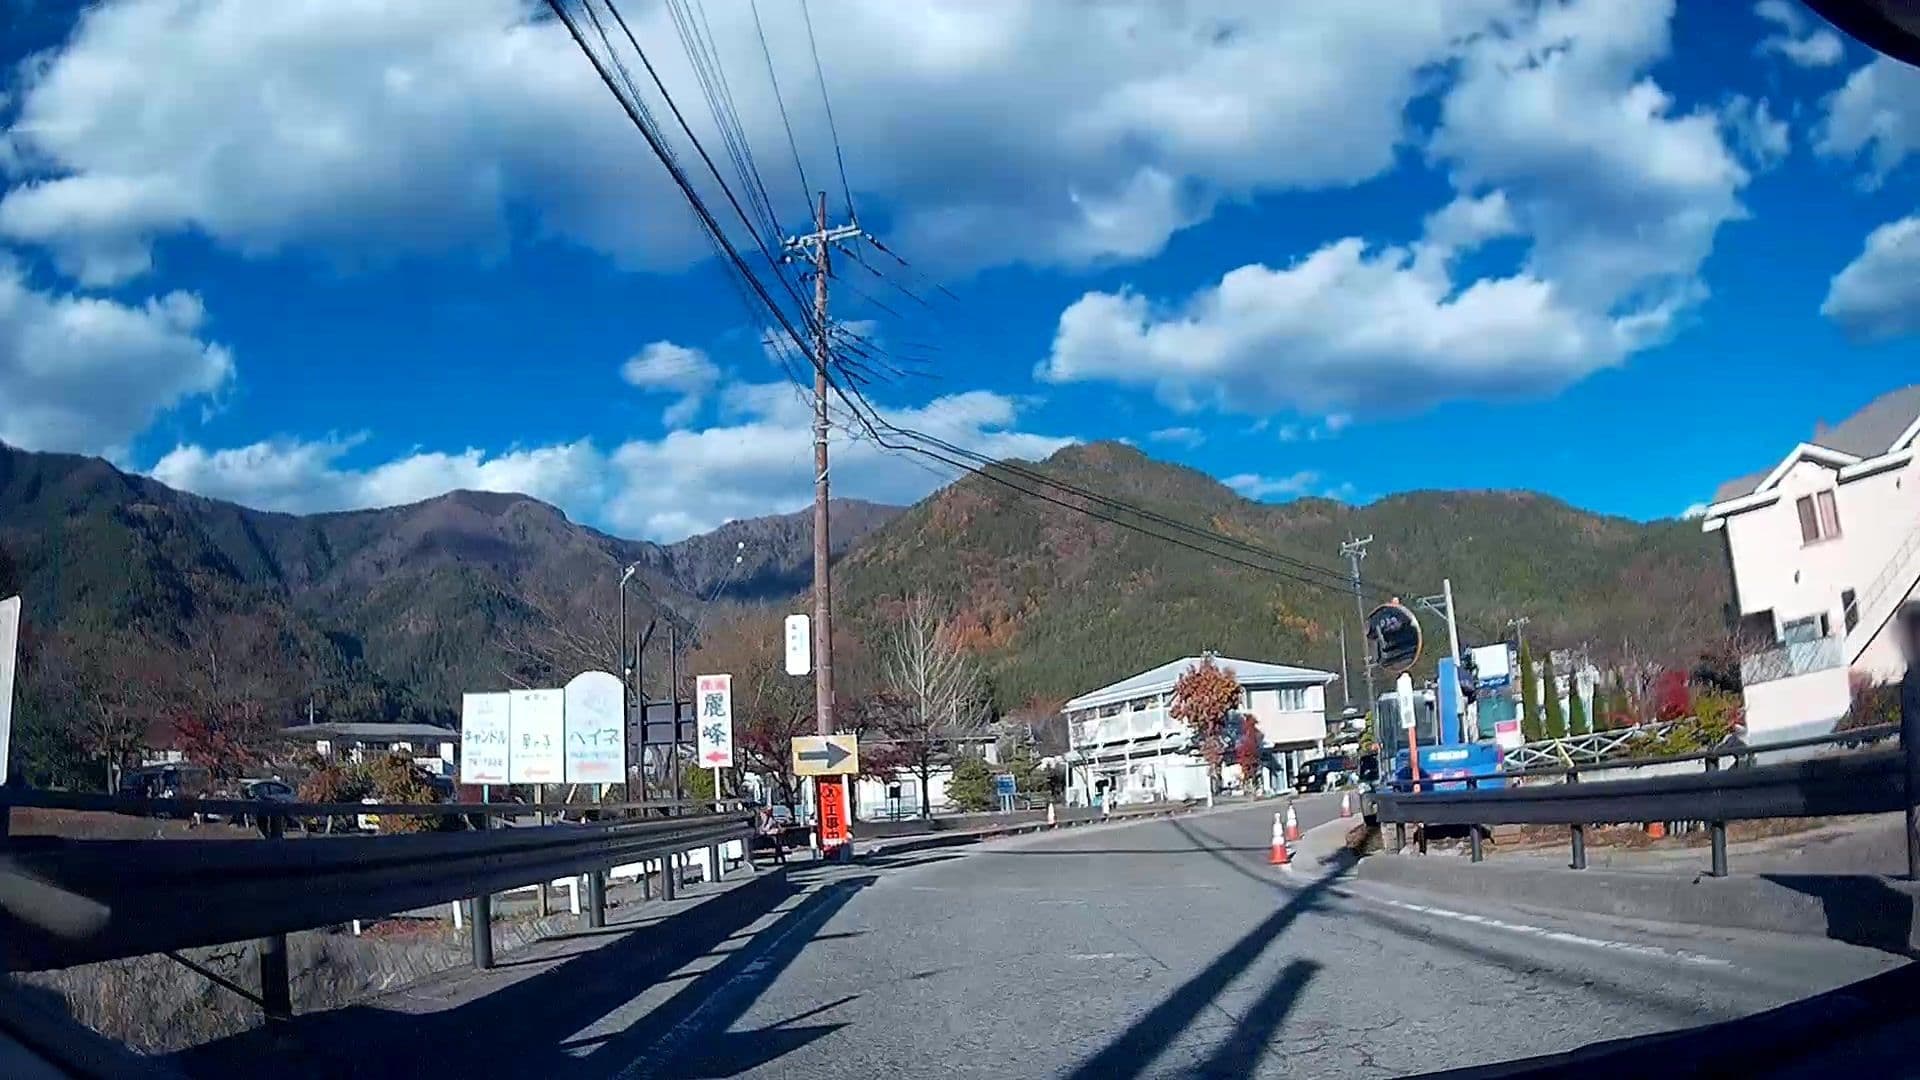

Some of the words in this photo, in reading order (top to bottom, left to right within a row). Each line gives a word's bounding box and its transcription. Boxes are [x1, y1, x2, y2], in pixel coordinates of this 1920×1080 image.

[464, 729, 506, 745] キャンドル
